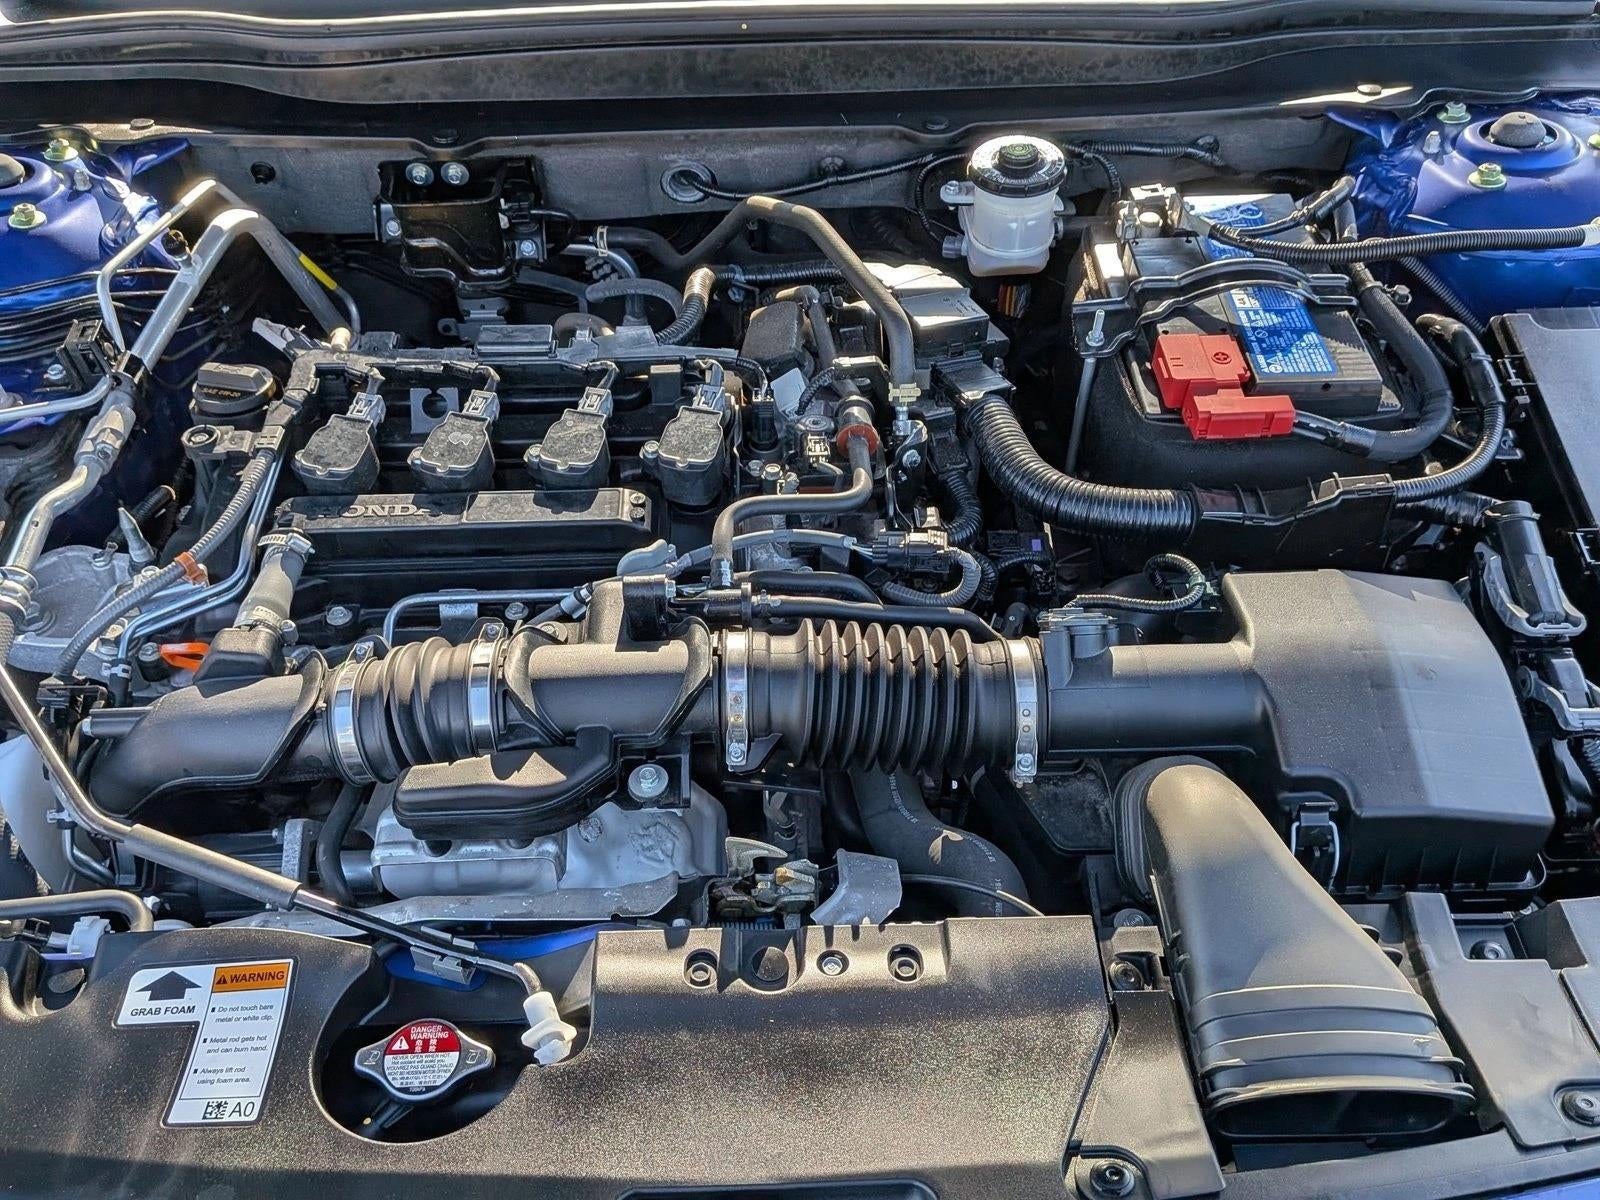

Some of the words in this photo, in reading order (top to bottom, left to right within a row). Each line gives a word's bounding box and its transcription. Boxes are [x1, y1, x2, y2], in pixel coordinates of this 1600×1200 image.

[230, 970, 285, 984] WARNING
[130, 1007, 162, 1016] GRAB
[164, 1005, 196, 1015] FOAM
[410, 1025, 442, 1033] DANGER
[410, 1031, 449, 1040] WARNUNG
[200, 1068, 224, 1076] Always
